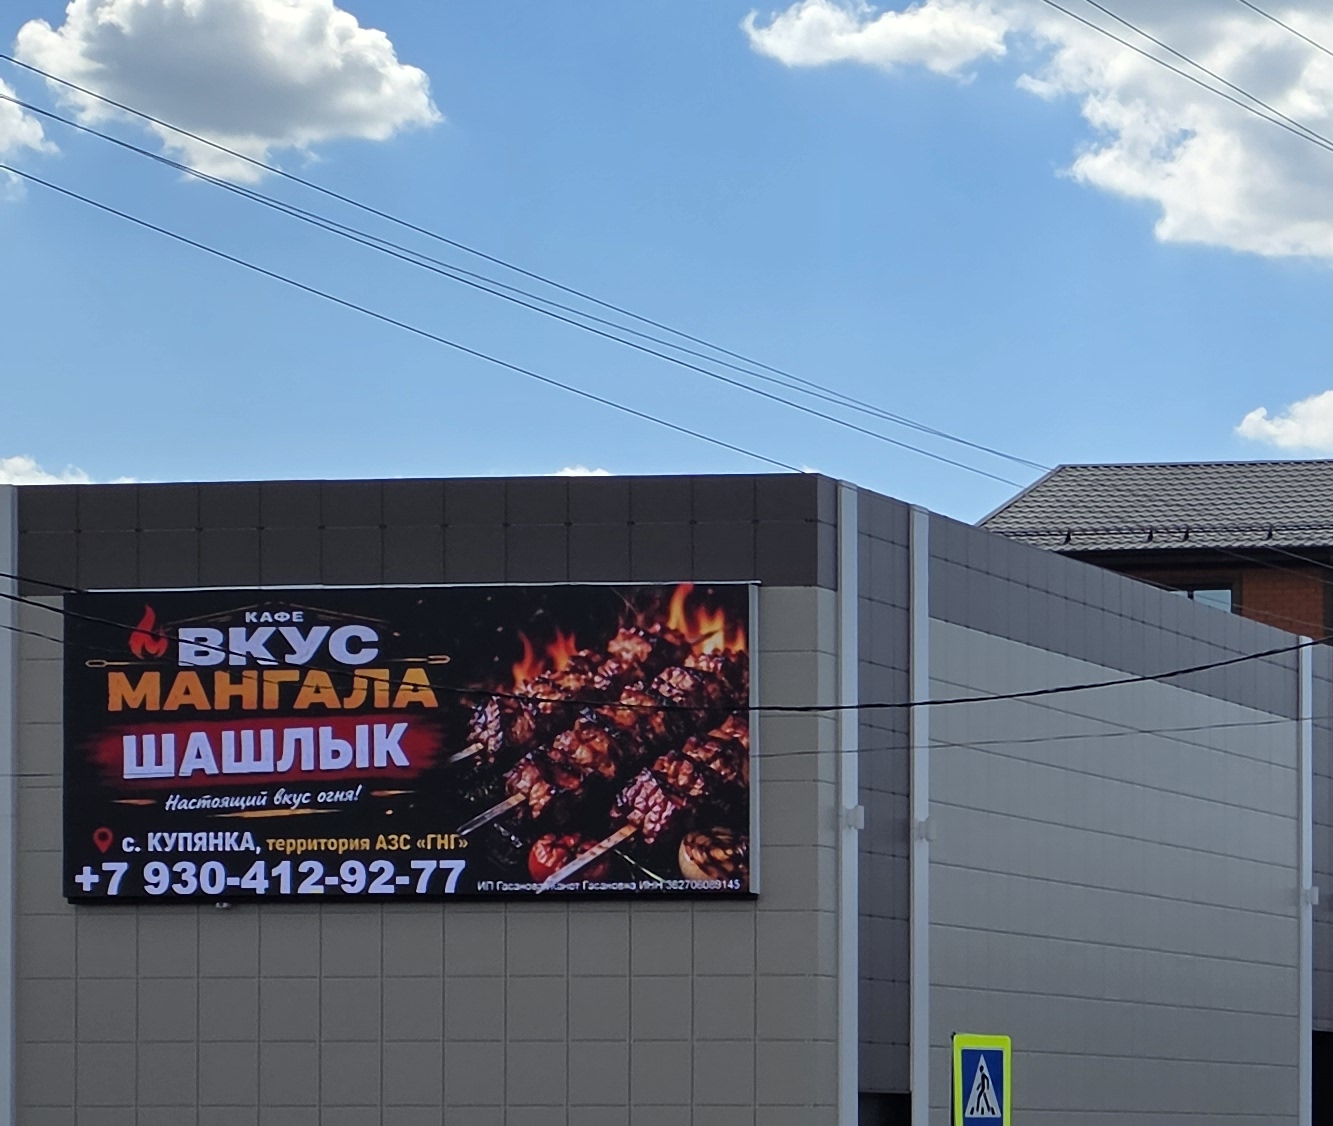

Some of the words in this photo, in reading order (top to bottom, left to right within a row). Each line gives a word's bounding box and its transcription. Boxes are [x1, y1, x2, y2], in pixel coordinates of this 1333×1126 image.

[246, 611, 304, 623] КАФЕ
[178, 625, 379, 667] ВКУС
[108, 668, 438, 711] МАНГАЛА
[123, 723, 410, 779] ШАШЛЫК
[165, 791, 268, 811] Настоящий
[273, 788, 312, 810] вкус
[316, 784, 363, 803] огня!
[122, 837, 141, 852] с.
[147, 832, 261, 854] КУПЯНКА,
[266, 838, 370, 855] территория
[375, 834, 411, 850] АЗС
[416, 834, 469, 850] «ГНГ»
[75, 862, 129, 895] +7
[143, 860, 466, 895] 930-412-92-77
[477, 881, 494, 891] ИП
